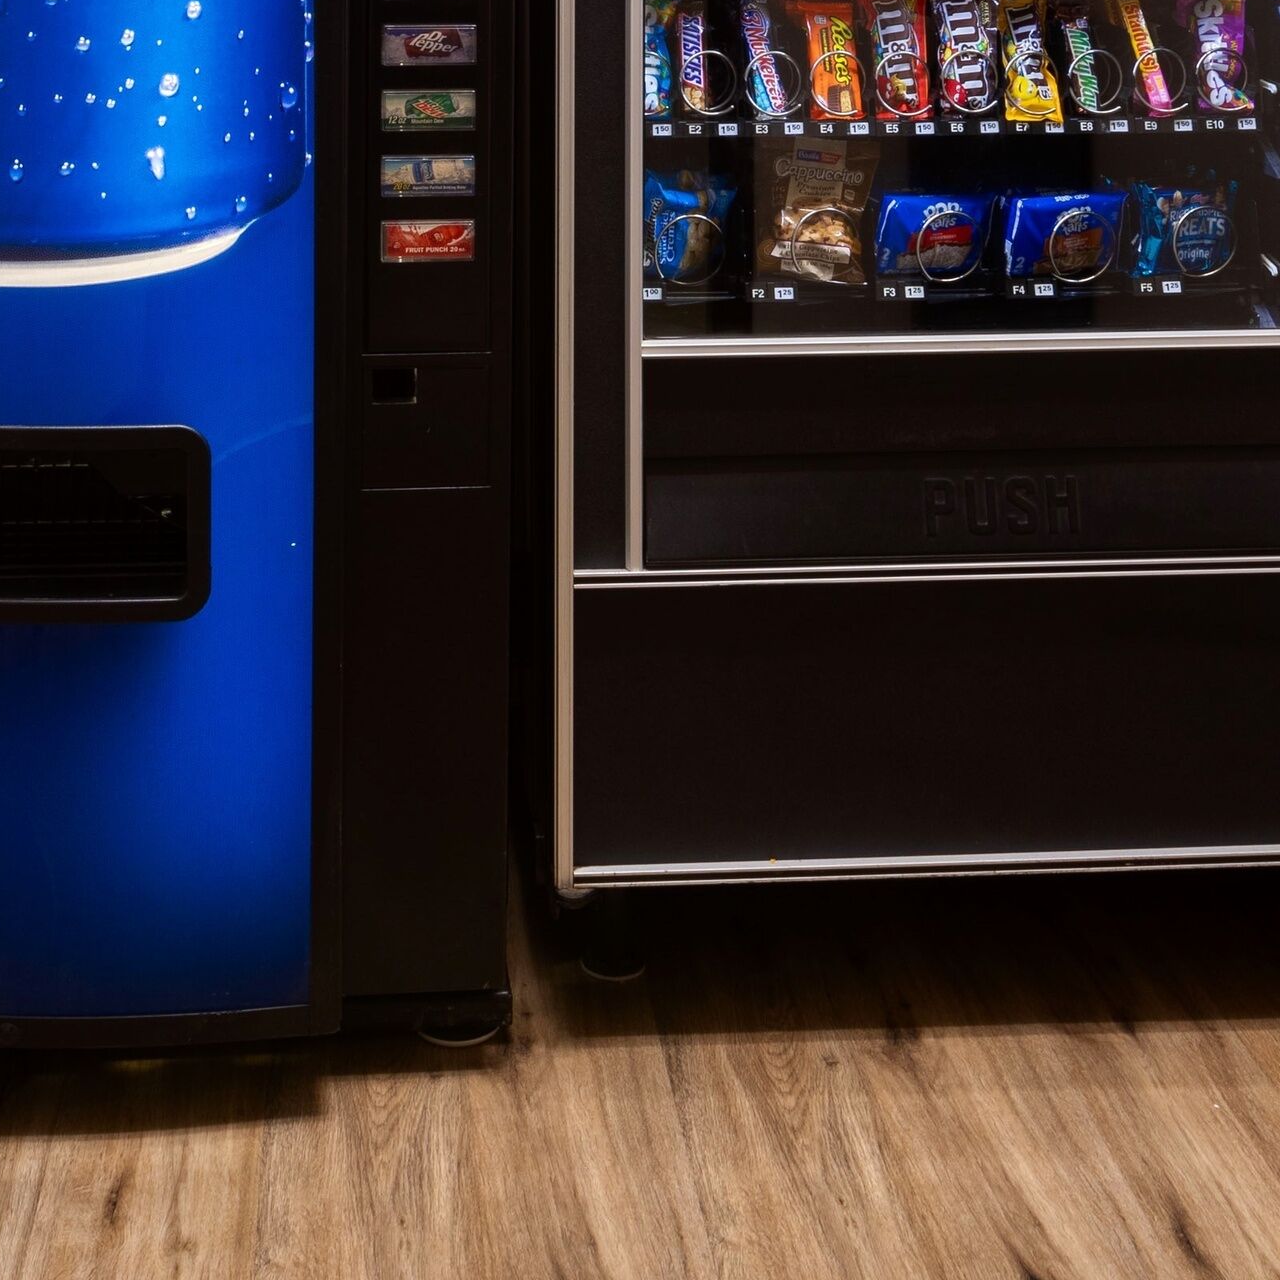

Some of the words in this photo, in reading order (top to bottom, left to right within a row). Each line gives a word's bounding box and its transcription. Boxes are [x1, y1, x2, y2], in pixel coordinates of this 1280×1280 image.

[428, 31, 447, 42] Dr
[409, 33, 459, 53] Pepper
[683, 15, 702, 85] SATISFIES
[830, 16, 853, 86] Reese's
[388, 116, 397, 124] 12
[1206, 120, 1224, 130] E10
[688, 125, 702, 134] E2
[755, 124, 769, 134] E3
[820, 124, 834, 134] E4
[886, 124, 899, 133] E5
[951, 123, 964, 133] E6
[1016, 122, 1030, 132] E7
[1080, 122, 1093, 131] E8
[1144, 121, 1157, 131] E9
[775, 158, 864, 184] Cappuccino
[1172, 217, 1225, 237] TREATS
[883, 287, 896, 297] F3
[1012, 285, 1025, 295] F4
[1140, 283, 1153, 292] F5
[752, 289, 765, 299] F2
[923, 475, 1081, 538] PUSH
